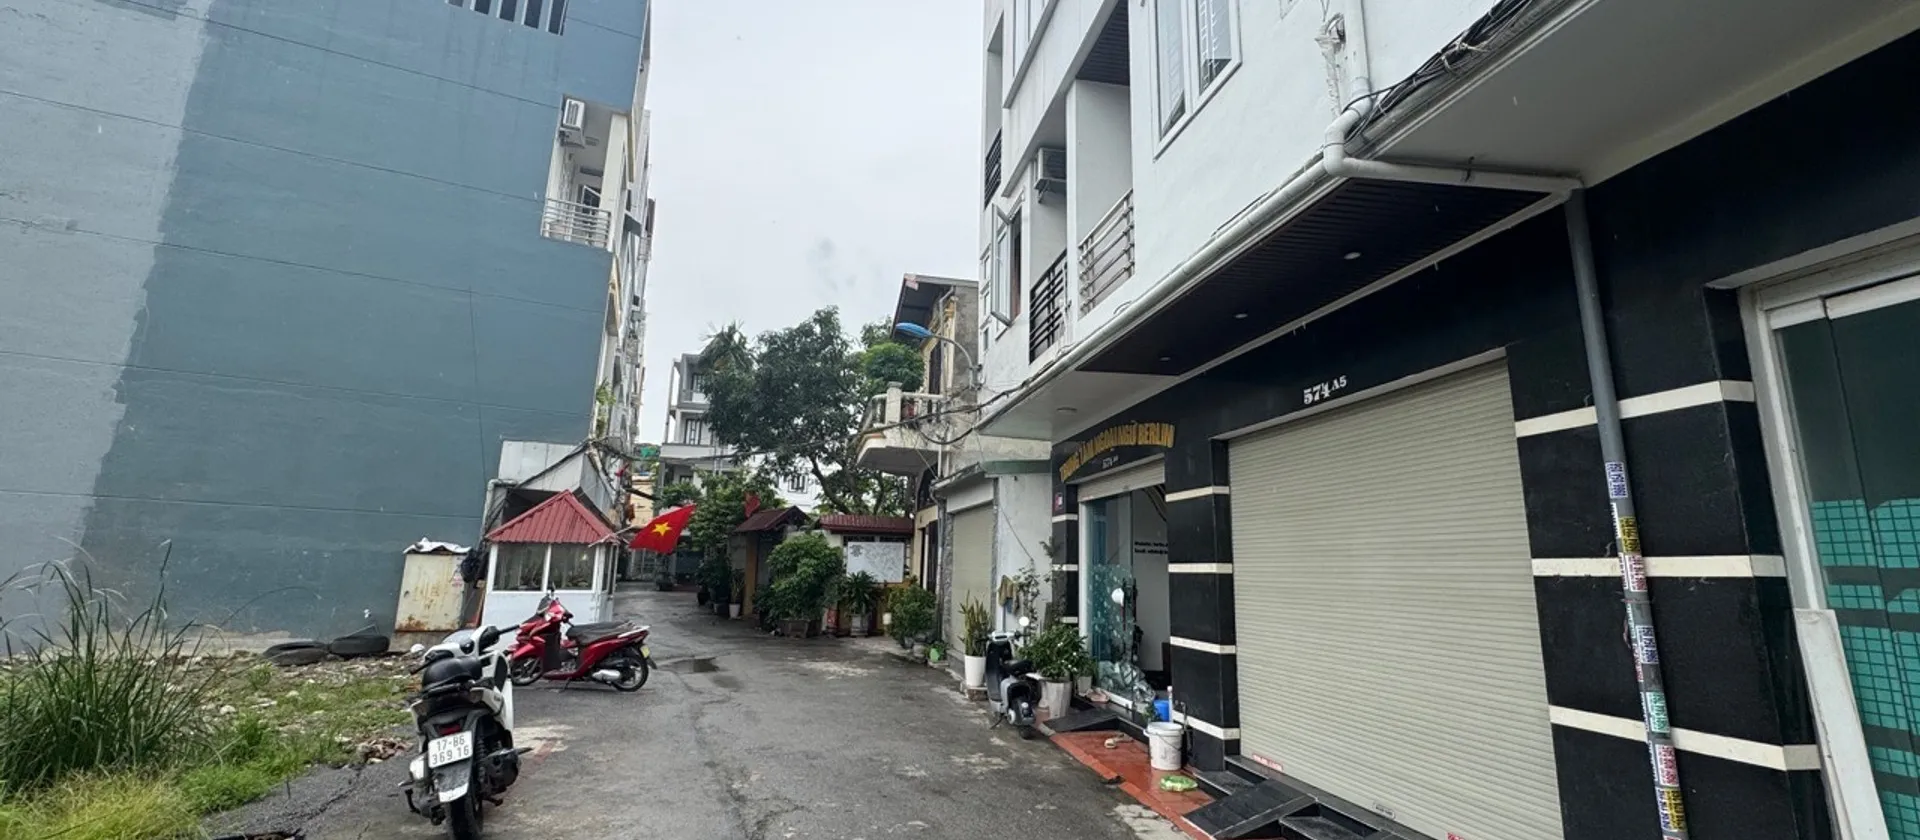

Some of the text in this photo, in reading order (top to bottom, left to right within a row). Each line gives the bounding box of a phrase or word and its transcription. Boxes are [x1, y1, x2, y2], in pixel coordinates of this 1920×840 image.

[1138, 422, 1175, 448] BERLIN
[432, 745, 470, 764] 369 16
